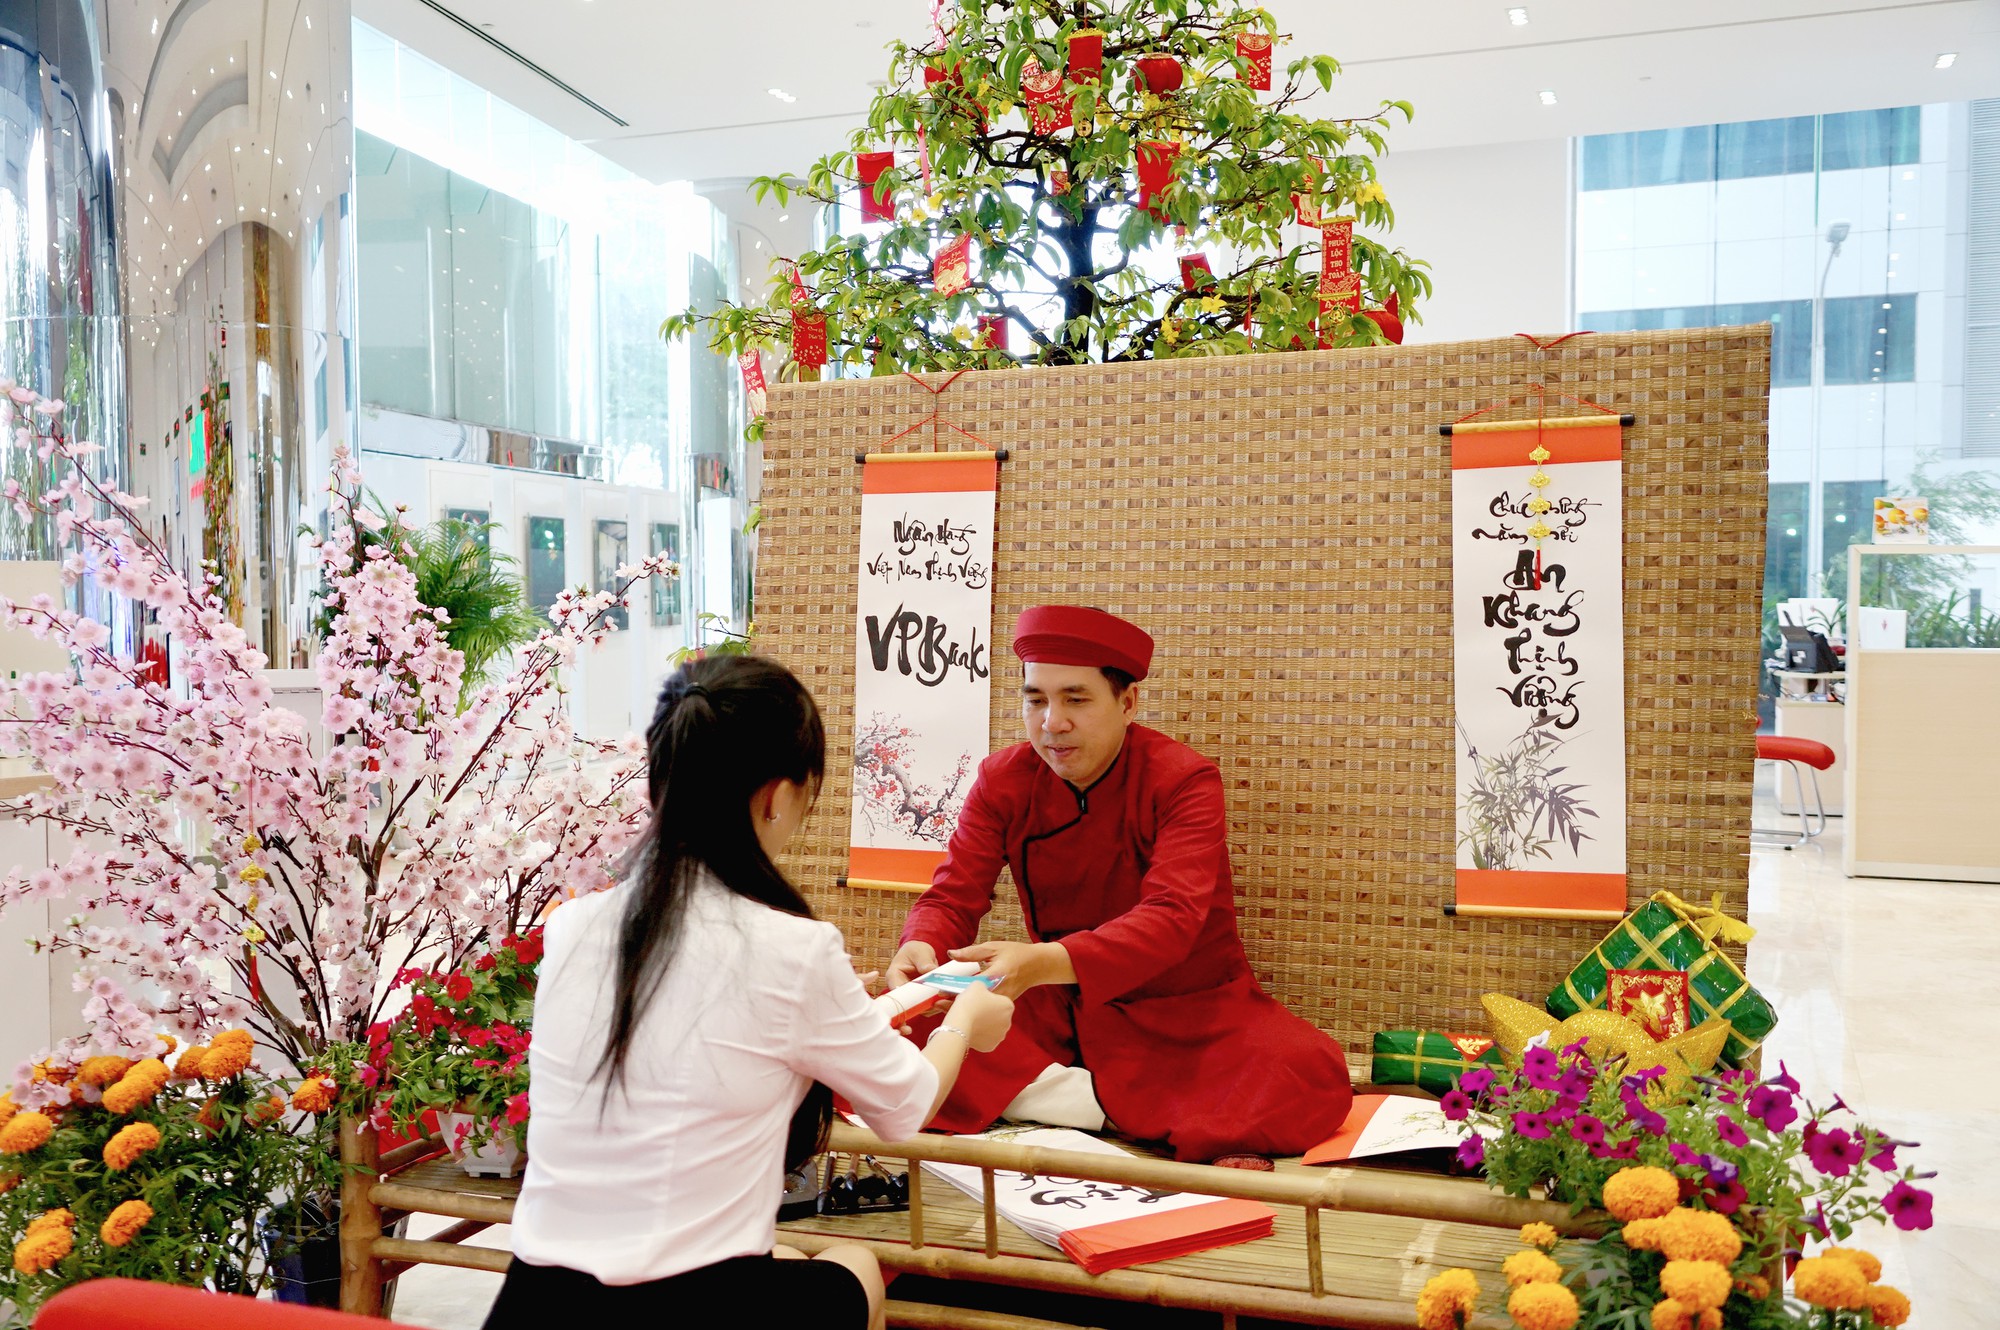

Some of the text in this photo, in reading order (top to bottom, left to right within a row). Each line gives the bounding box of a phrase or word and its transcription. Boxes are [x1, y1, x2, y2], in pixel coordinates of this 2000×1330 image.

[1503, 549, 1567, 593] An
[1482, 589, 1585, 637] Khang
[864, 600, 989, 687] VPBank
[1503, 627, 1579, 677] Thịnh
[1495, 674, 1586, 730] Vượng
